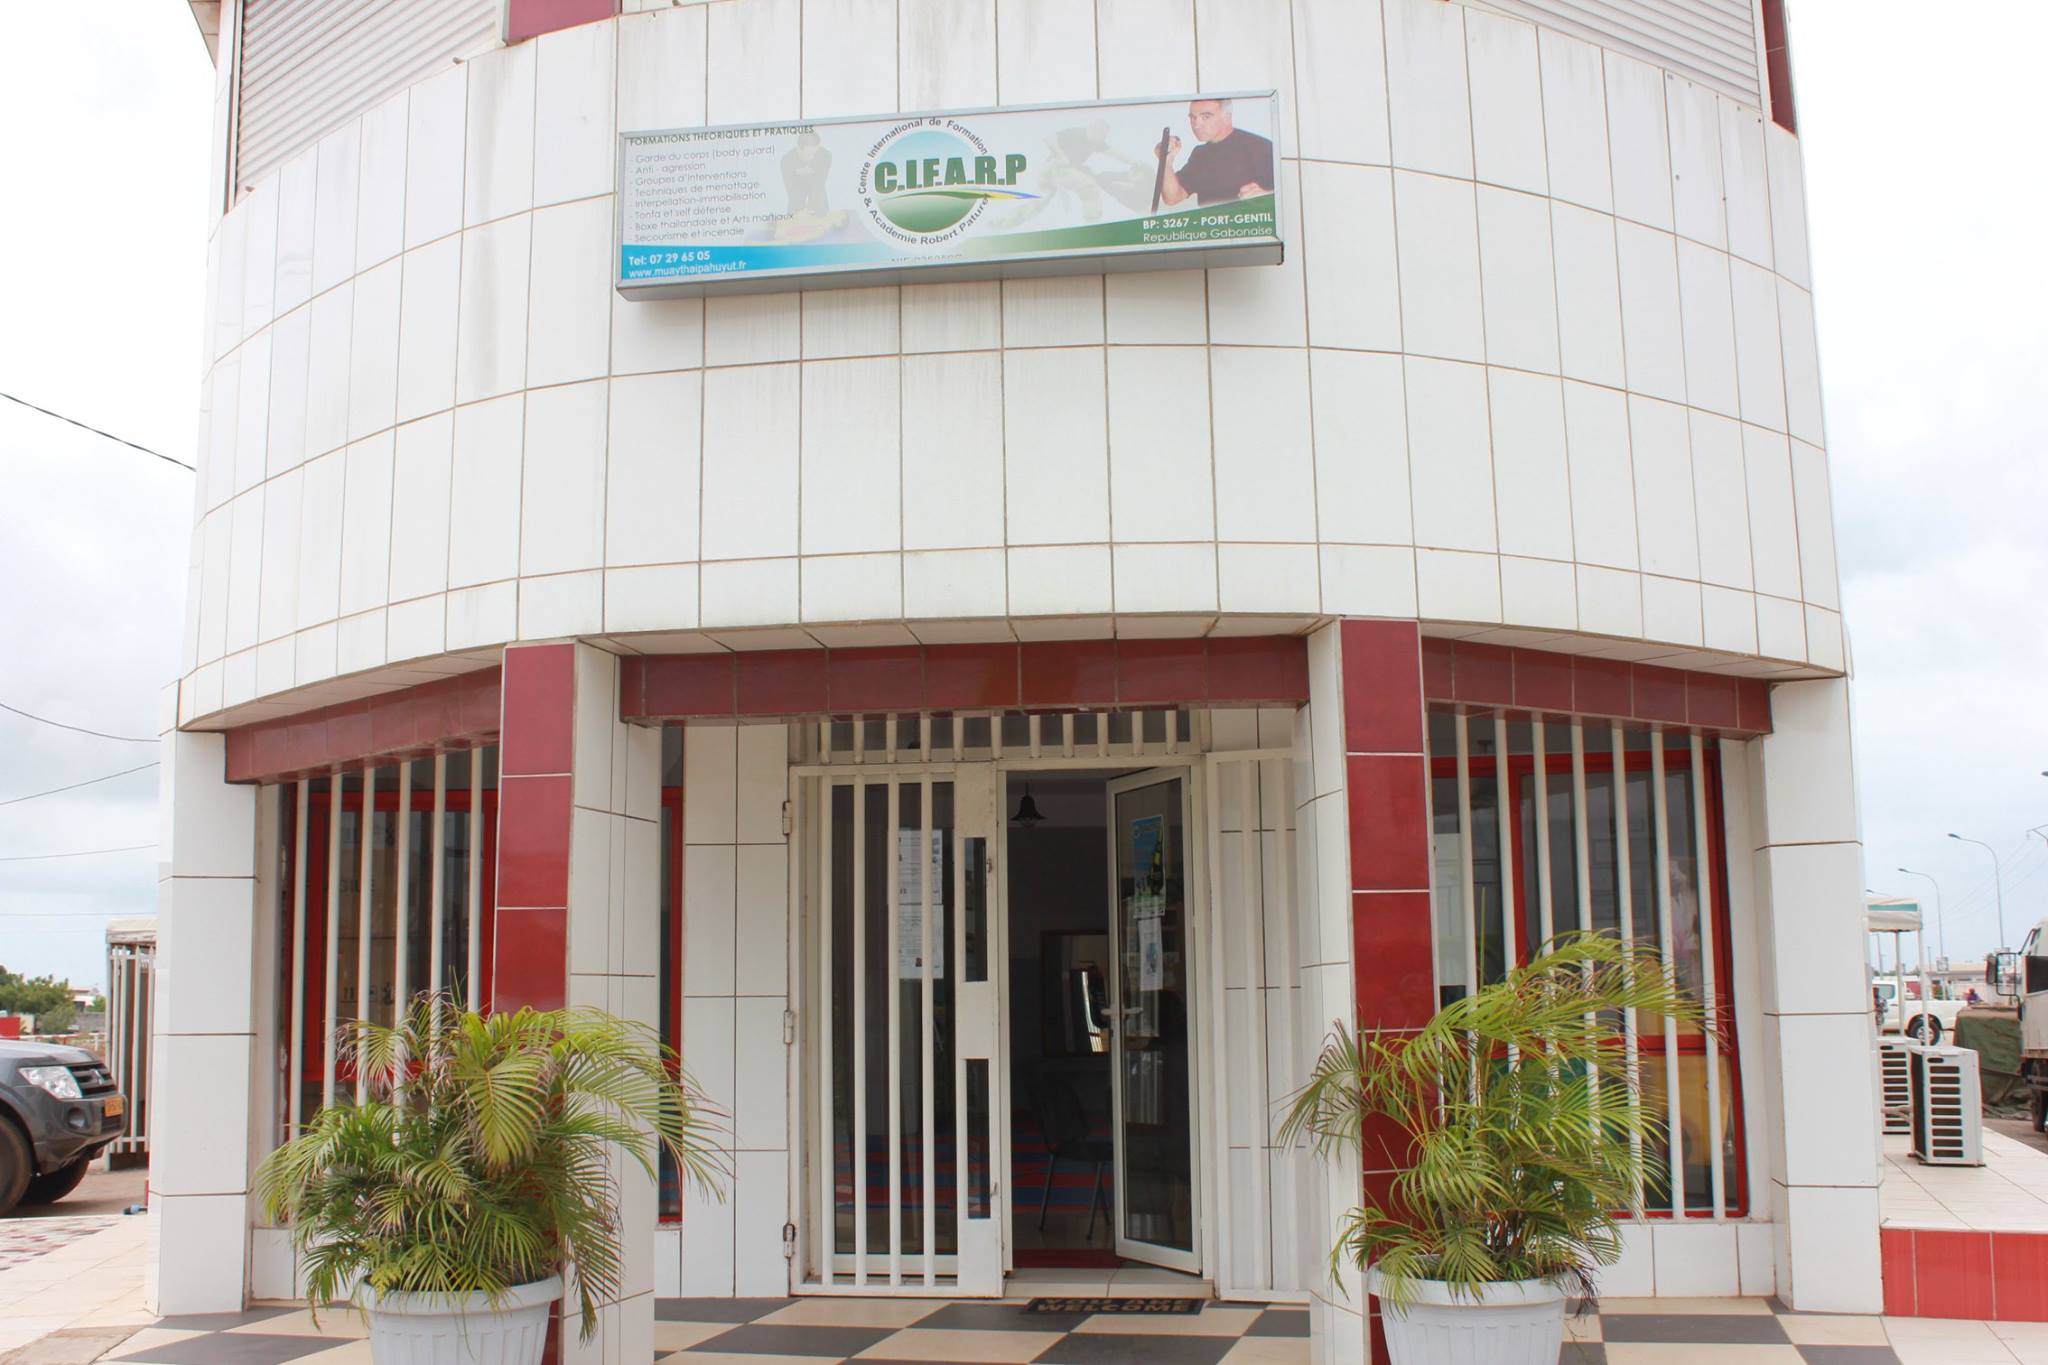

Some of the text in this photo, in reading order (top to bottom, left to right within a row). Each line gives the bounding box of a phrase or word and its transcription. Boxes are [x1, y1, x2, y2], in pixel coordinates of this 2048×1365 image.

[630, 133, 690, 146] FORMATIONS
[752, 128, 761, 137] ET
[765, 125, 814, 136] PRATIQUES
[635, 143, 775, 163] Garde du corps (body guard)
[858, 117, 988, 194] Centre International de Formation
[635, 166, 654, 174] Anti
[662, 162, 706, 174] agression
[635, 177, 675, 186] Groupes
[635, 180, 760, 197] Techniques de menottage
[635, 210, 661, 219] Tonfa
[664, 209, 673, 217] et
[674, 207, 691, 217] self
[635, 222, 658, 231] Boxe
[720, 216, 729, 225] et
[732, 213, 749, 223] Arts
[752, 211, 794, 222] martiaux
[1143, 220, 1160, 230] BP:
[1163, 218, 1189, 228] 3267
[1200, 213, 1273, 226] PORT-GENTIL
[635, 227, 745, 242] Secourisme et incendie
[920, 230, 958, 245] Robert
[1143, 226, 1273, 242] Republique Gabonaise
[649, 254, 663, 264] 07
[665, 253, 678, 263] 29
[681, 251, 695, 261] 65
[697, 250, 711, 260] 05
[1037, 1303, 1191, 1312] WELCOME
